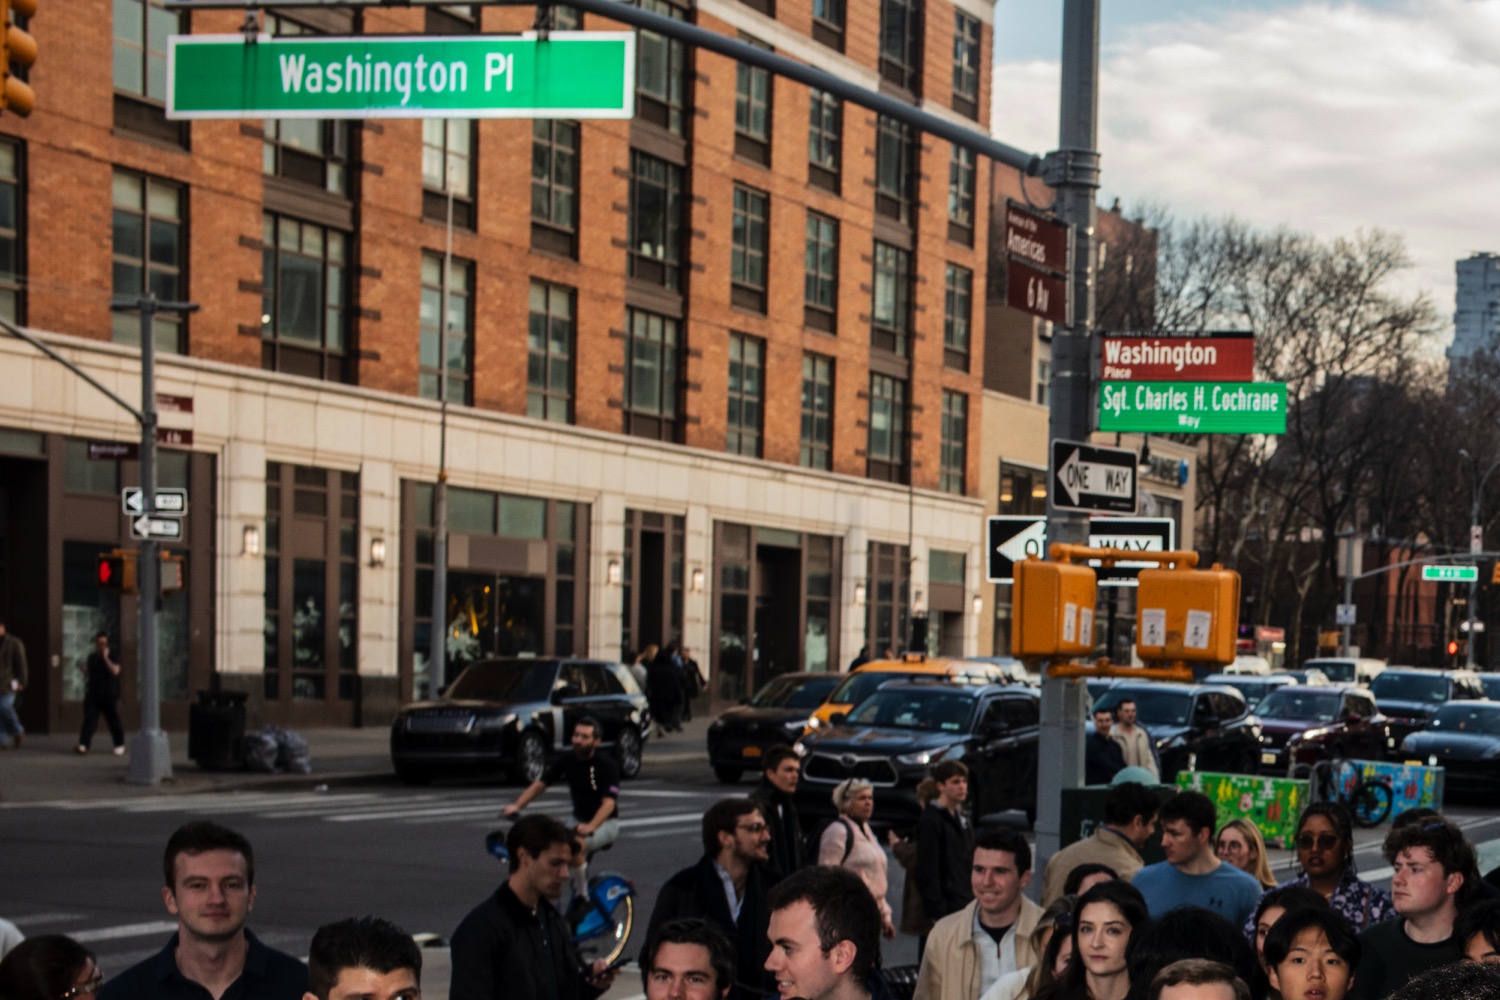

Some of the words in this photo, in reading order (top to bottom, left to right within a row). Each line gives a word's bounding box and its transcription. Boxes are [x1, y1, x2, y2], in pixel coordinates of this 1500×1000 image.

[279, 52, 467, 104] Washington
[484, 52, 514, 92] Pl
[1007, 226, 1046, 263] Americas
[1027, 276, 1035, 309] 6
[1036, 279, 1050, 314] Av
[1103, 365, 1132, 379] Place
[1104, 340, 1218, 372] Washington
[1103, 384, 1131, 417] Sgt.
[1135, 384, 1188, 411] Charles
[1193, 386, 1208, 411] H.
[1211, 385, 1279, 412] Cochrane
[1177, 413, 1201, 429] Way
[1066, 463, 1090, 489] ONE
[1104, 468, 1130, 493] WAY
